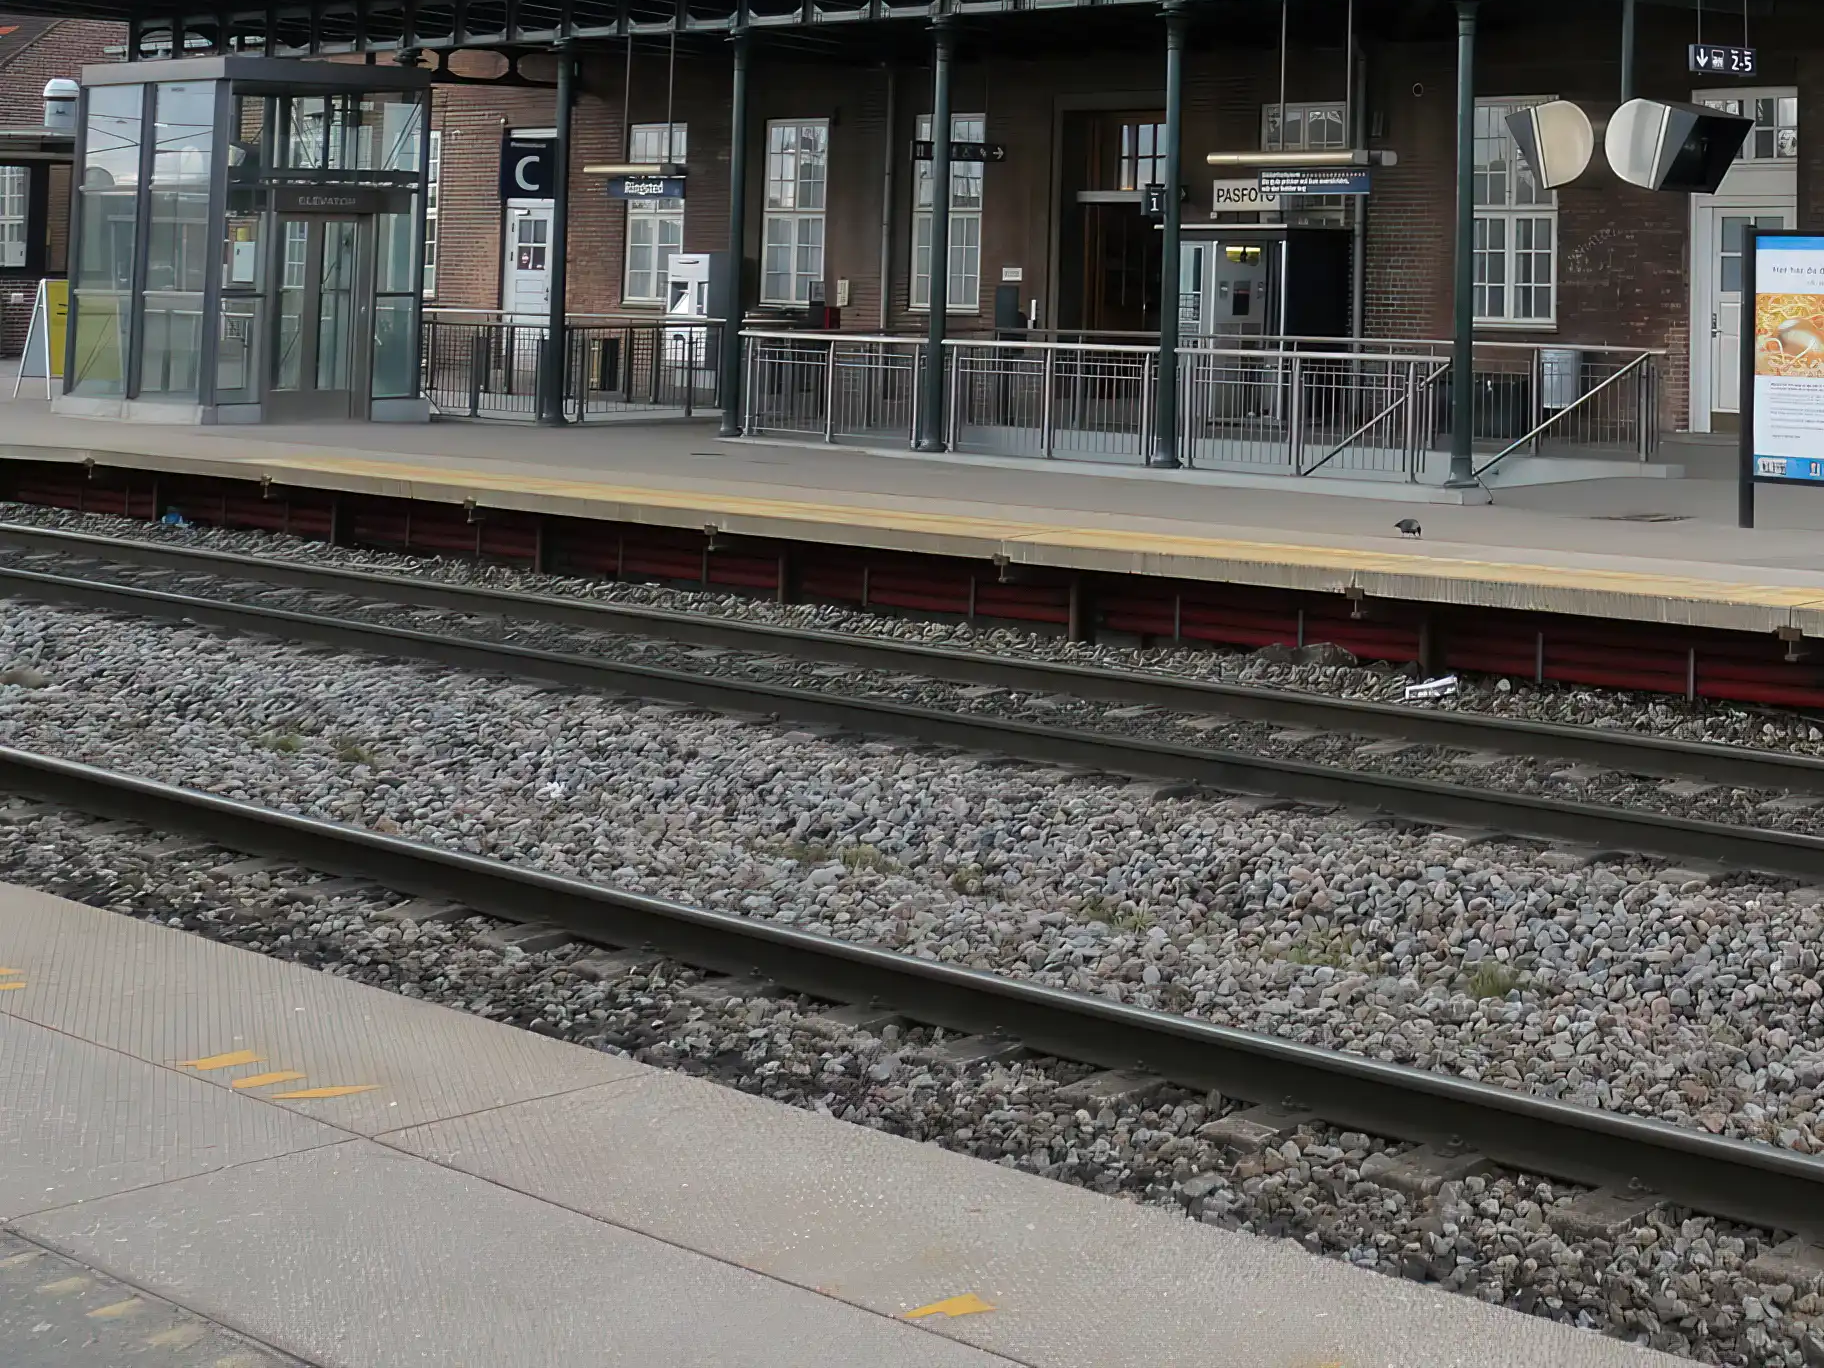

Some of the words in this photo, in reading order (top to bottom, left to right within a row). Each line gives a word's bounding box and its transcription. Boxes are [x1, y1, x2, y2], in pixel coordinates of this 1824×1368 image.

[515, 155, 540, 191] C
[624, 181, 664, 195] Ringsted
[1150, 197, 1159, 211] 1
